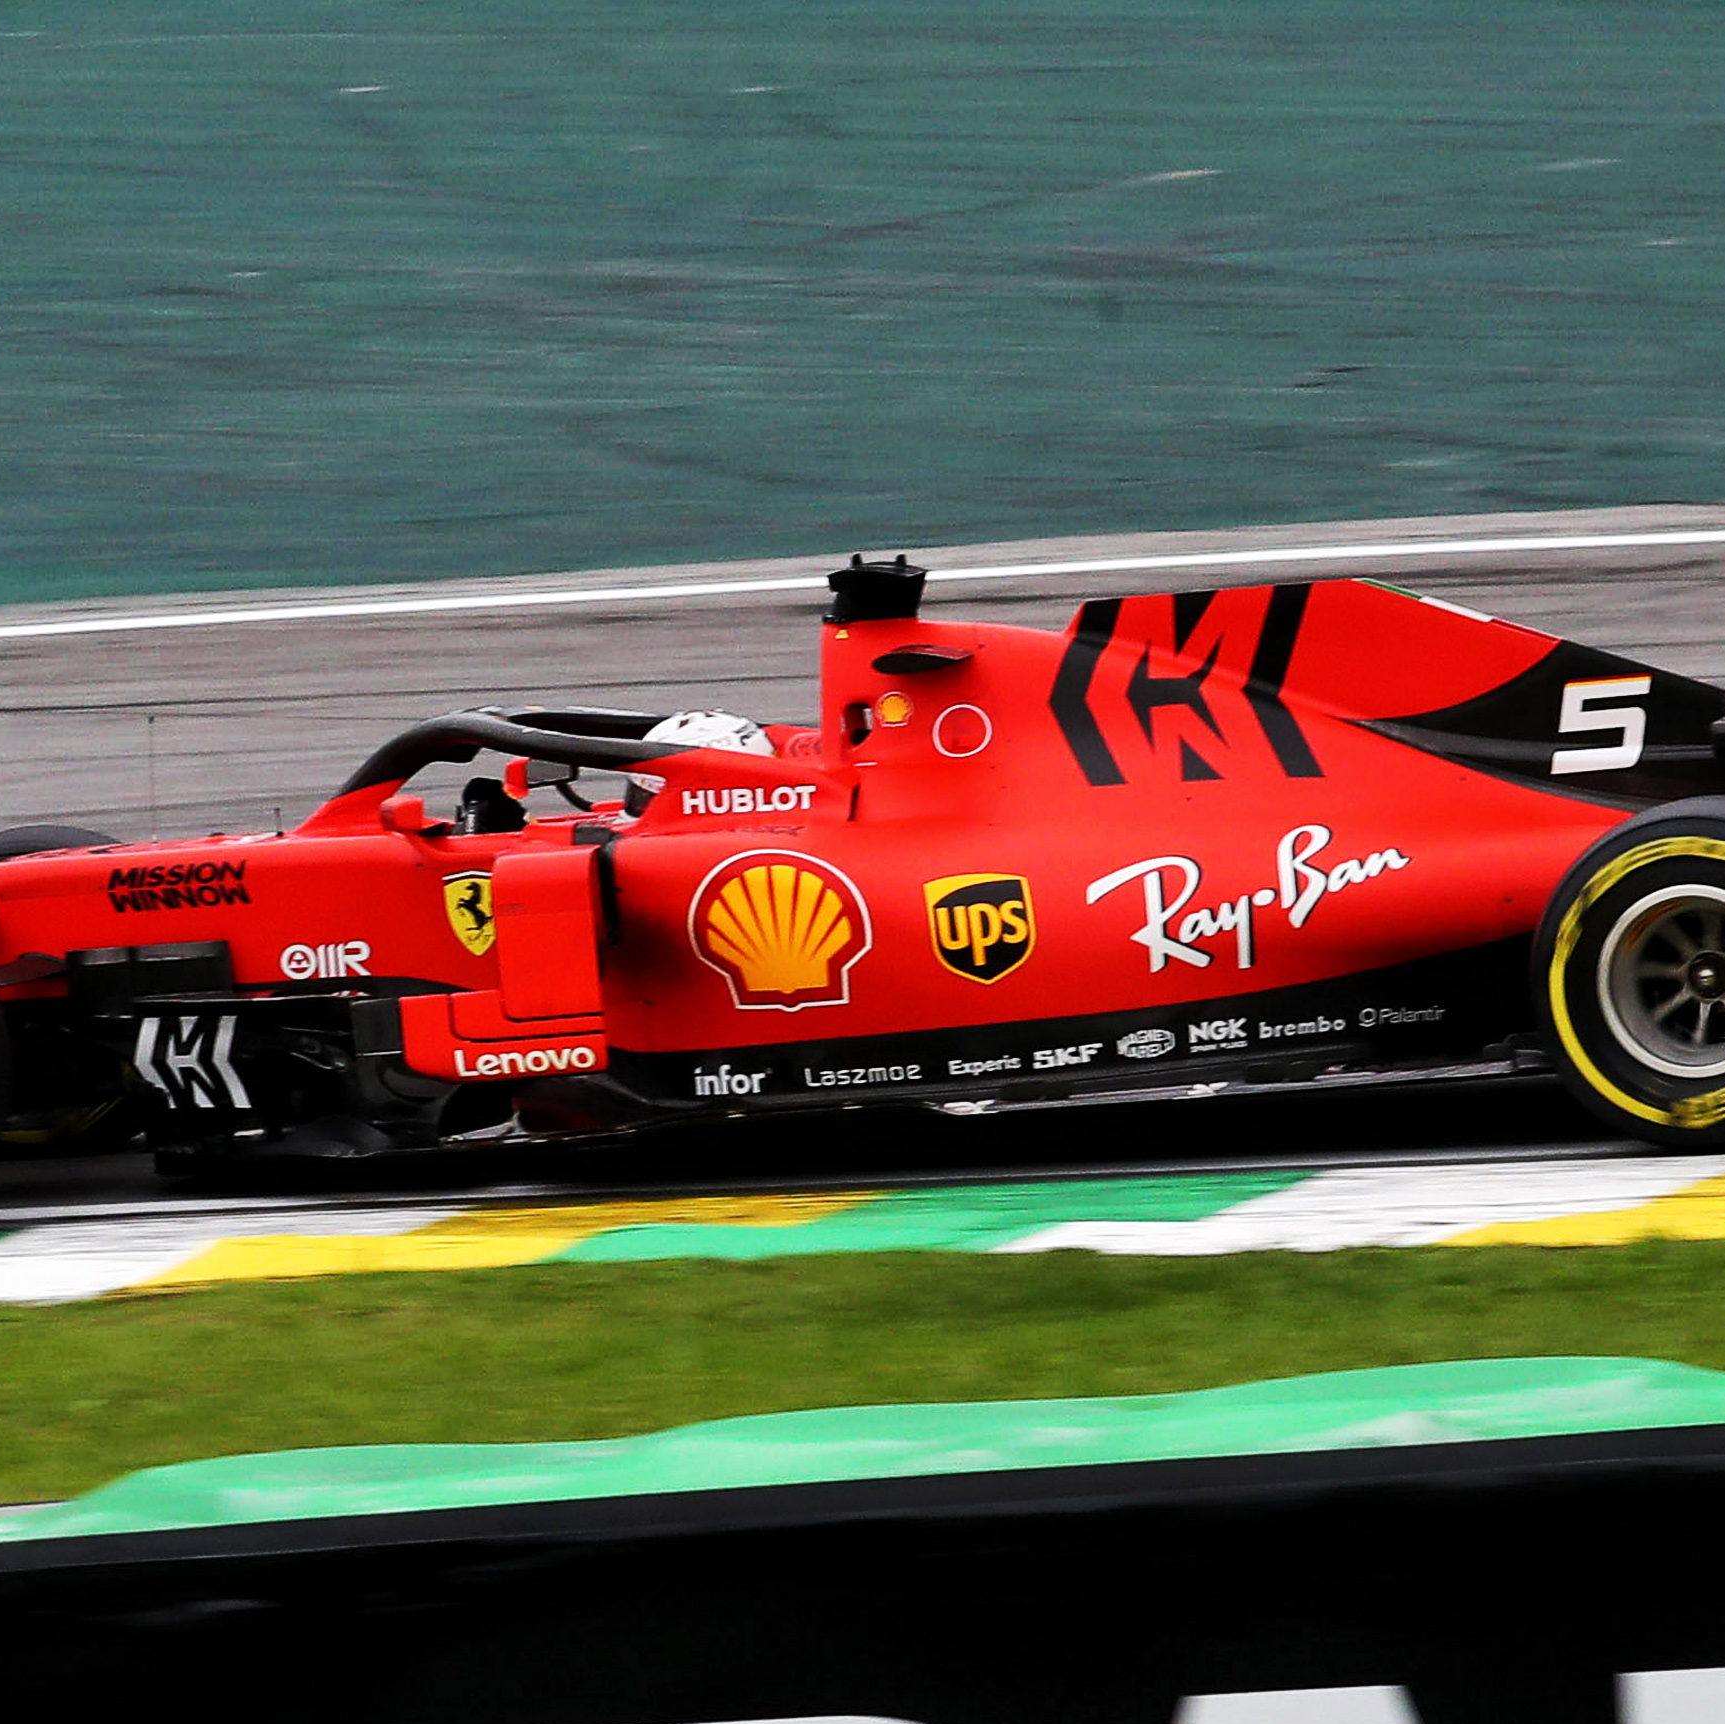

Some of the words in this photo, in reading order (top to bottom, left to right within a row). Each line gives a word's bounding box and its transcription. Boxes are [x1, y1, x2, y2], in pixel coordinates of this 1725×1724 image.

[1550, 673, 1653, 775] 5
[682, 785, 817, 815] HUBLOT
[108, 860, 246, 890] MISSION
[108, 883, 251, 913] WINNOW
[1259, 1016, 1346, 1039] brembo
[1379, 1005, 1446, 1024] Palantir
[1188, 1017, 1248, 1044] NGK
[454, 1047, 595, 1078] Lenovo
[948, 1055, 1022, 1076] Experis
[1032, 1043, 1104, 1069] SKF
[694, 1064, 766, 1095] infor
